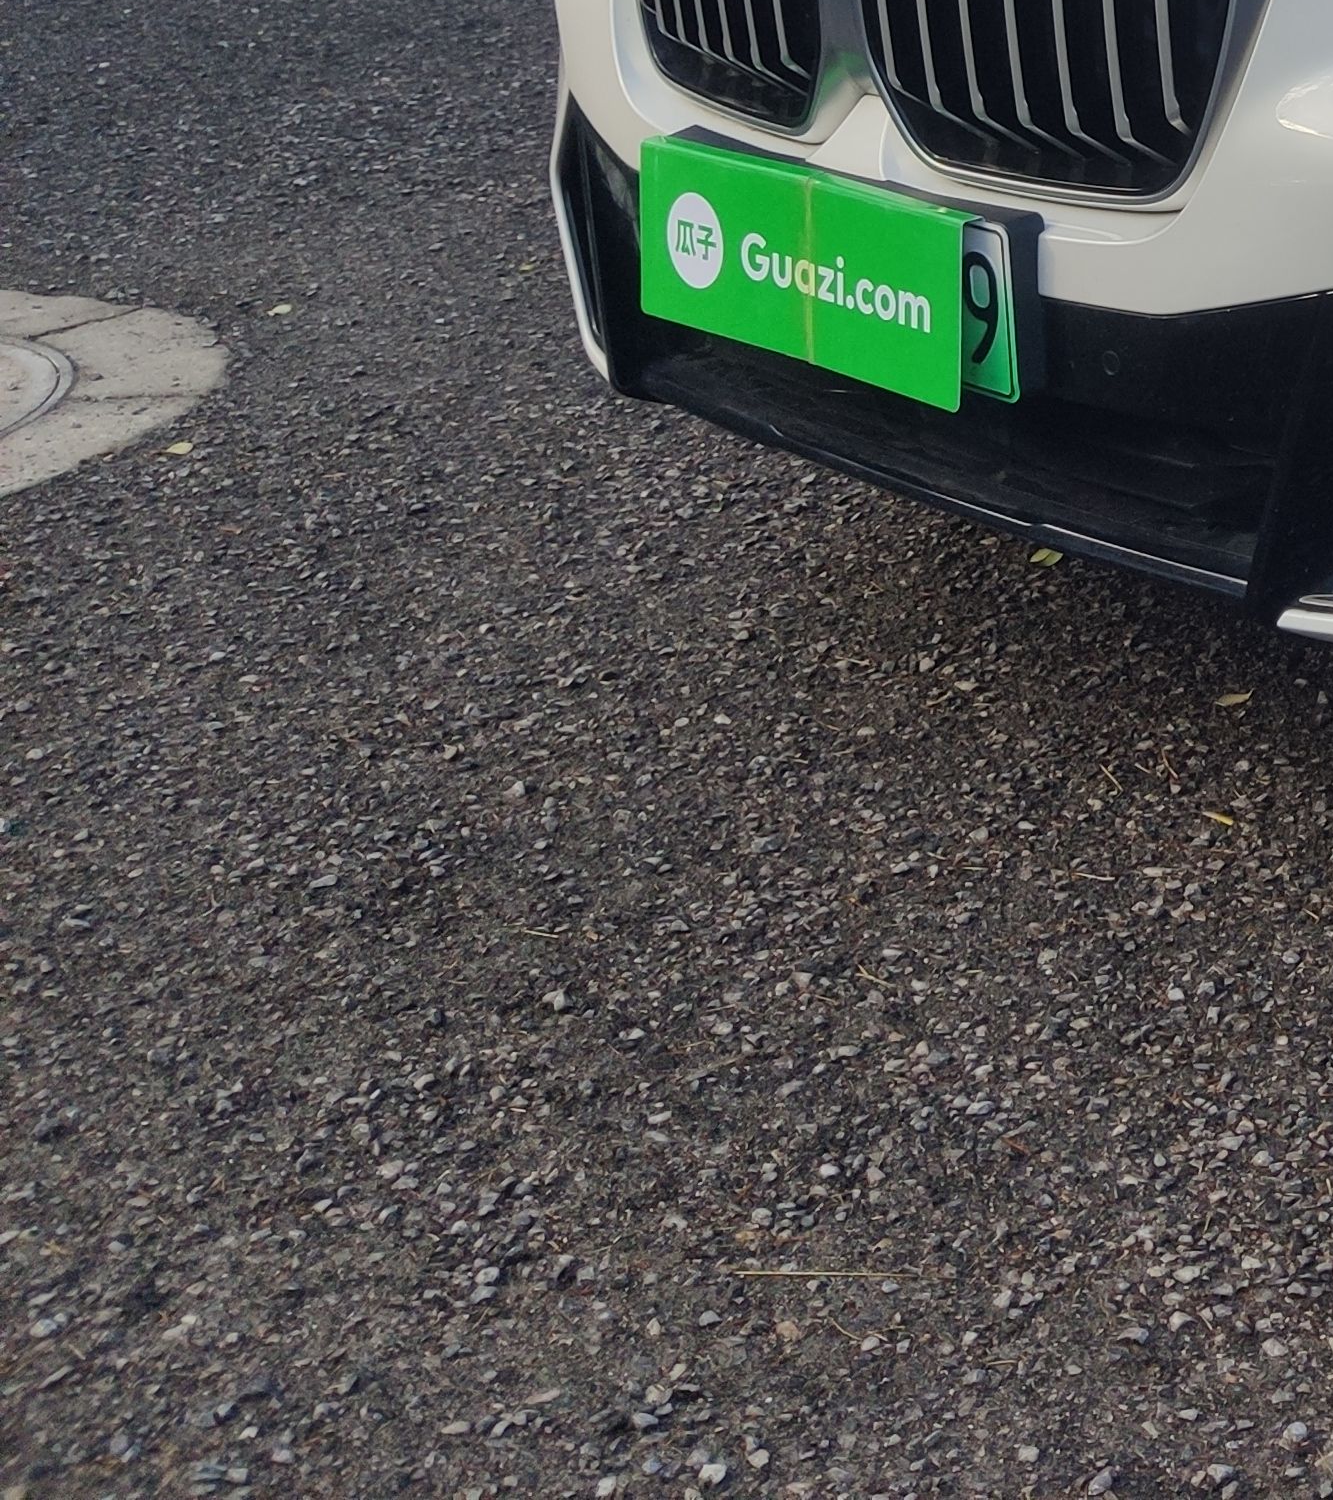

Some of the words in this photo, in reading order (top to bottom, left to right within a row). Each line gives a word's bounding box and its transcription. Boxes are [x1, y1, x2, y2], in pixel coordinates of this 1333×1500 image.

[675, 219, 717, 261] 瓜子
[740, 232, 931, 334] Guazi.com
[962, 250, 999, 366] 9
